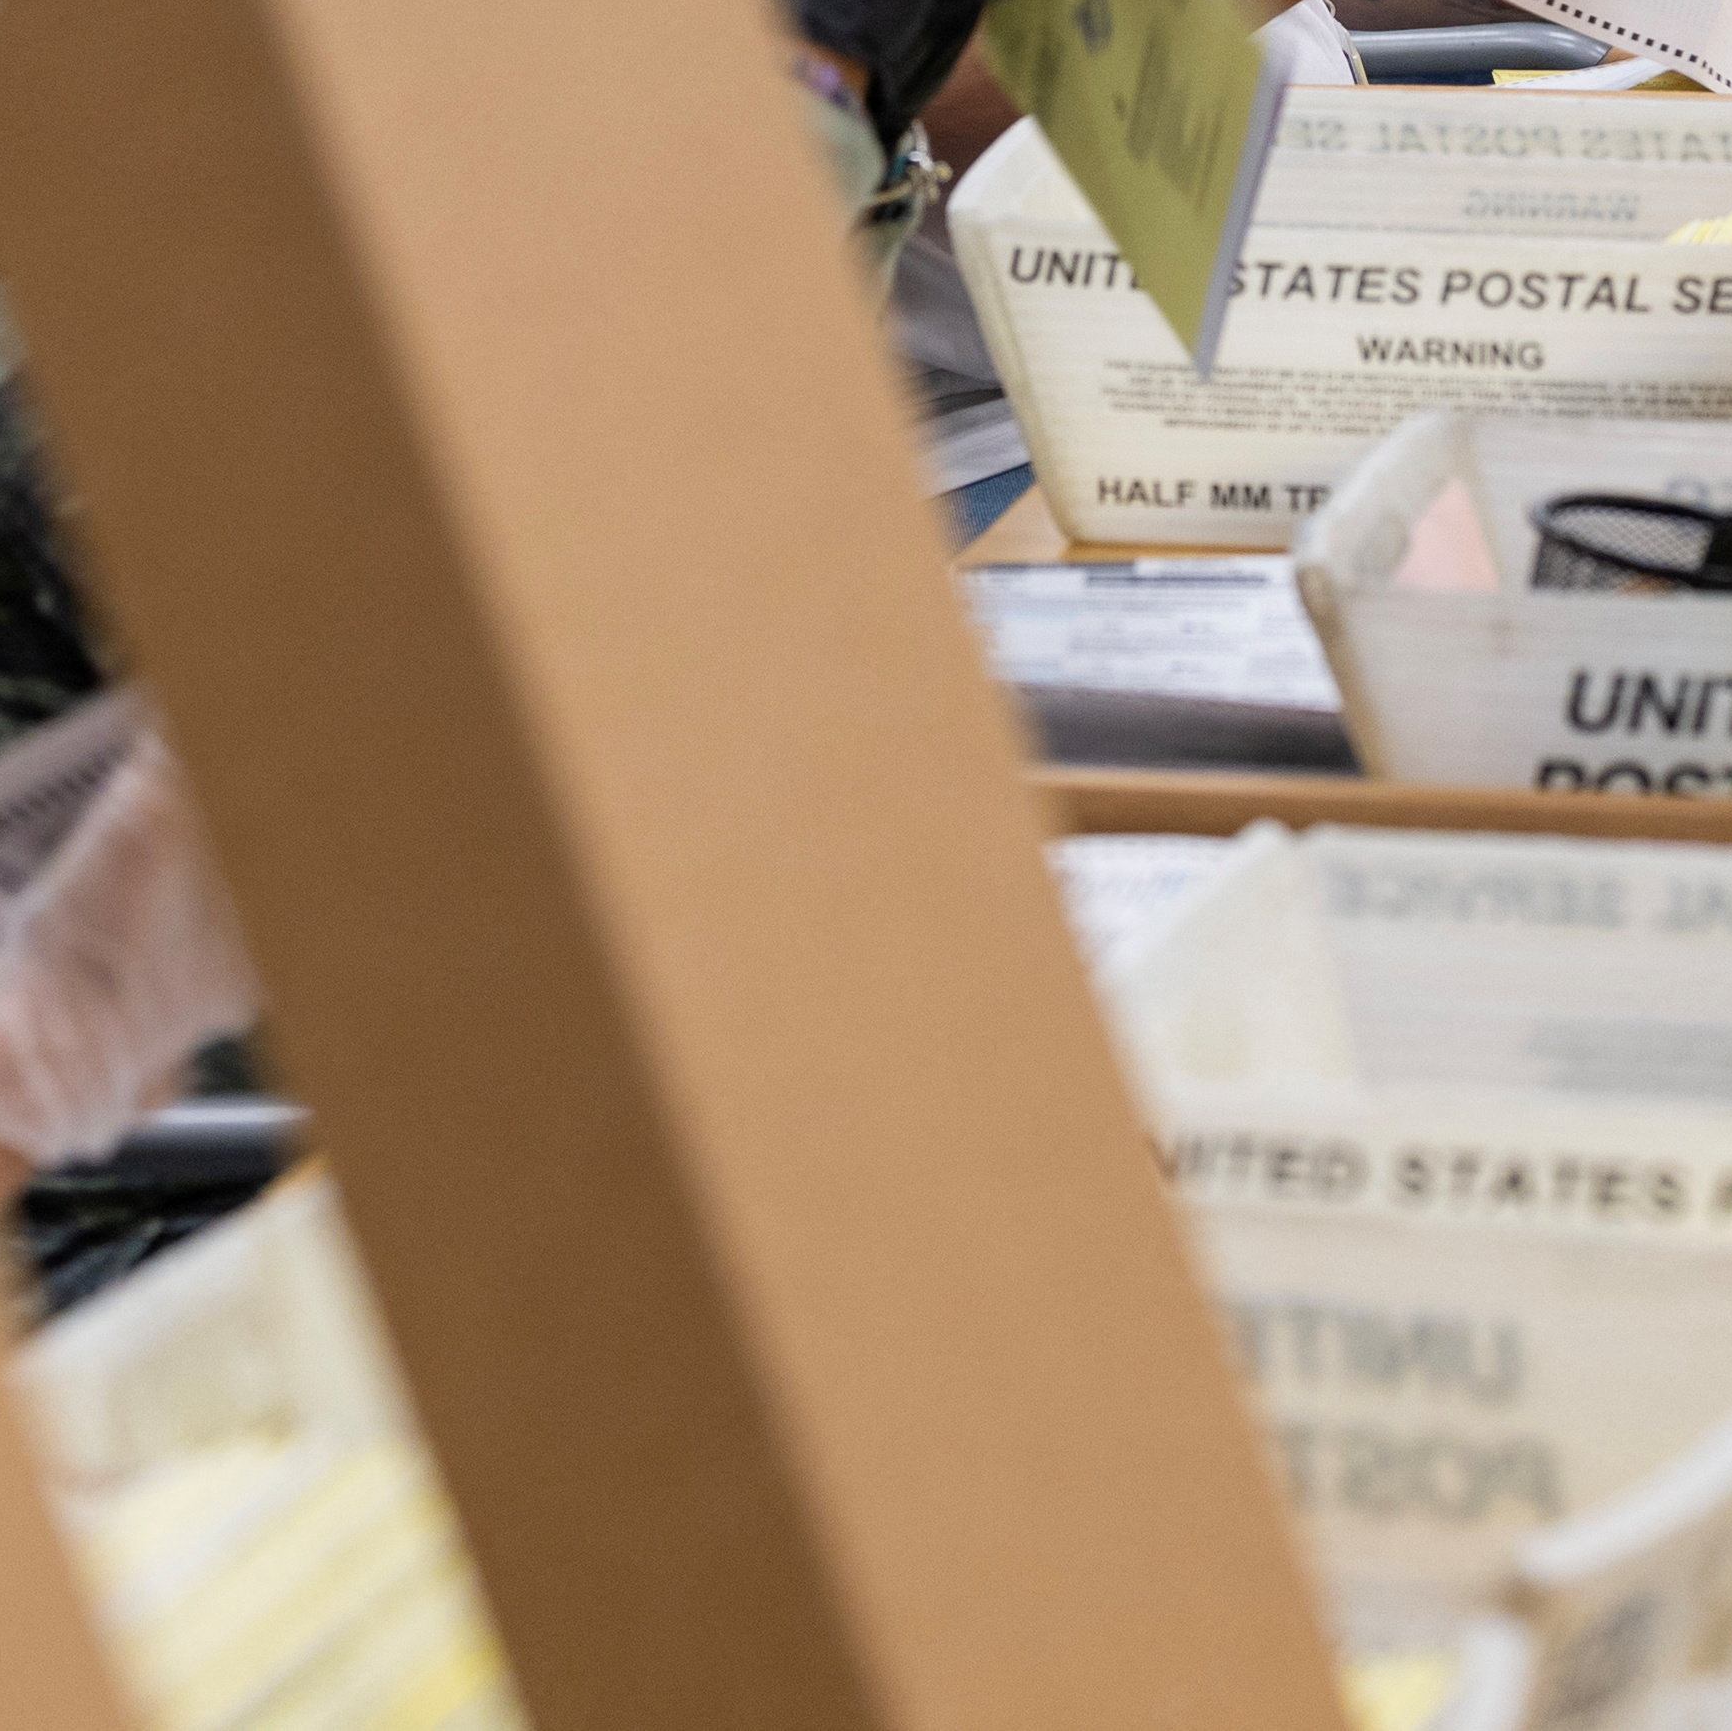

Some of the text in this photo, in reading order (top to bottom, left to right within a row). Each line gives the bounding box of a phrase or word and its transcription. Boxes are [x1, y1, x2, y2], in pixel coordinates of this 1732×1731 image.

[1010, 247, 1141, 291] UNIT
[1439, 269, 1653, 314] POSTAL
[1357, 334, 1546, 371] WARNING
[1097, 477, 1196, 508] HALF
[1149, 1133, 1368, 1207] NITED
[1389, 1138, 1691, 1226] STATES
